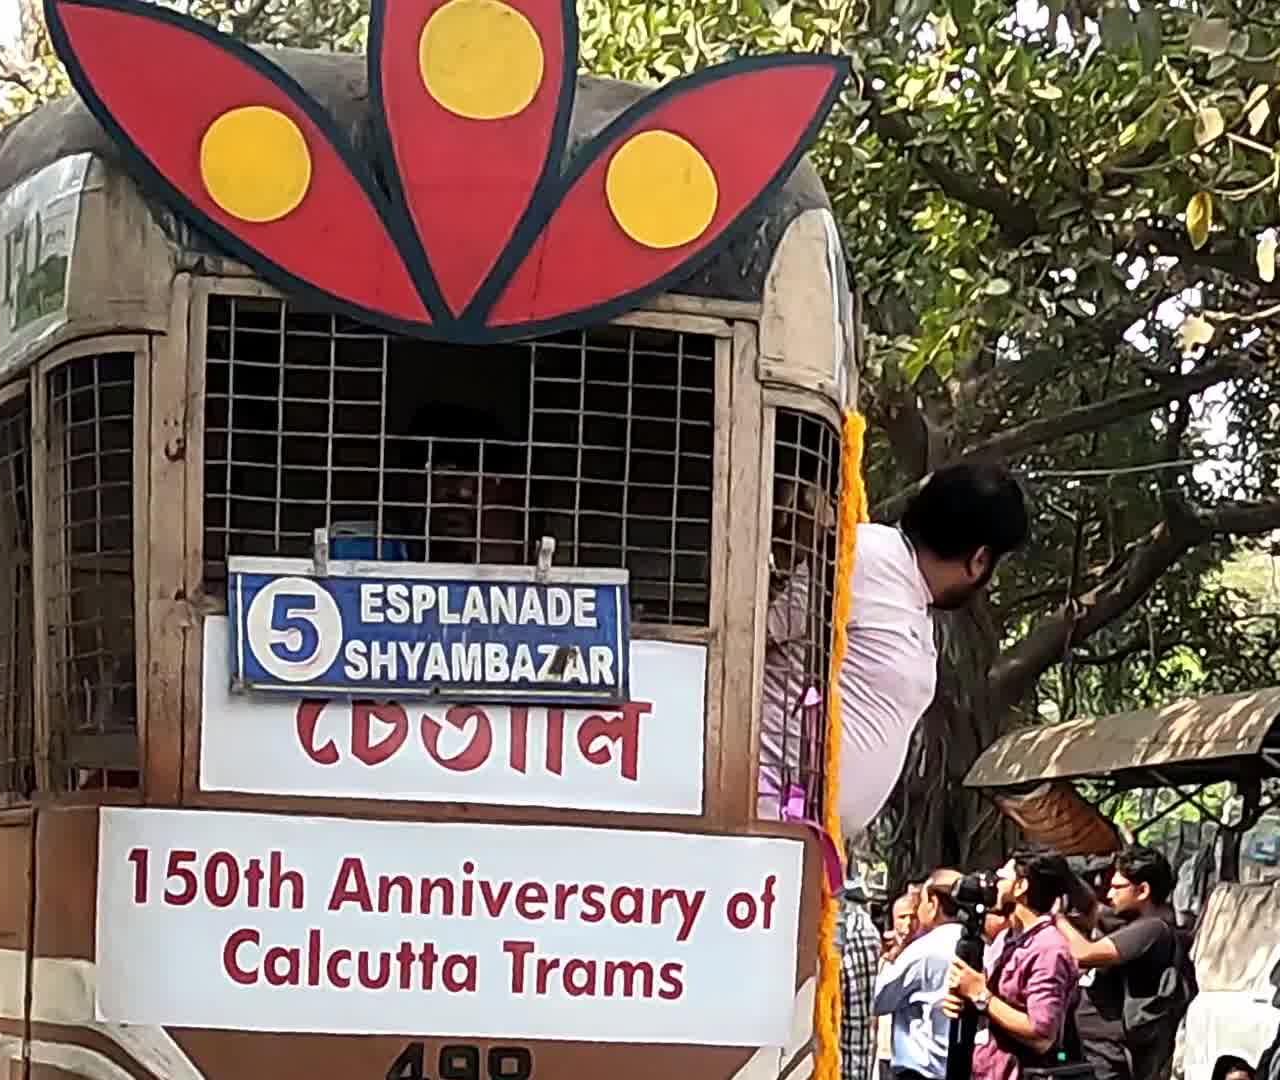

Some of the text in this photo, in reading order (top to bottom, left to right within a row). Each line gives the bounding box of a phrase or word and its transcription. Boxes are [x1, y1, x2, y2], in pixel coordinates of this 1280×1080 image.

[268, 593, 320, 664] 5
[359, 584, 597, 627] ESPLANADE
[344, 639, 615, 686] SHYAMBAZAR
[127, 848, 776, 941] 150th Anniversary of
[223, 929, 691, 1000] Calcutta Trams
